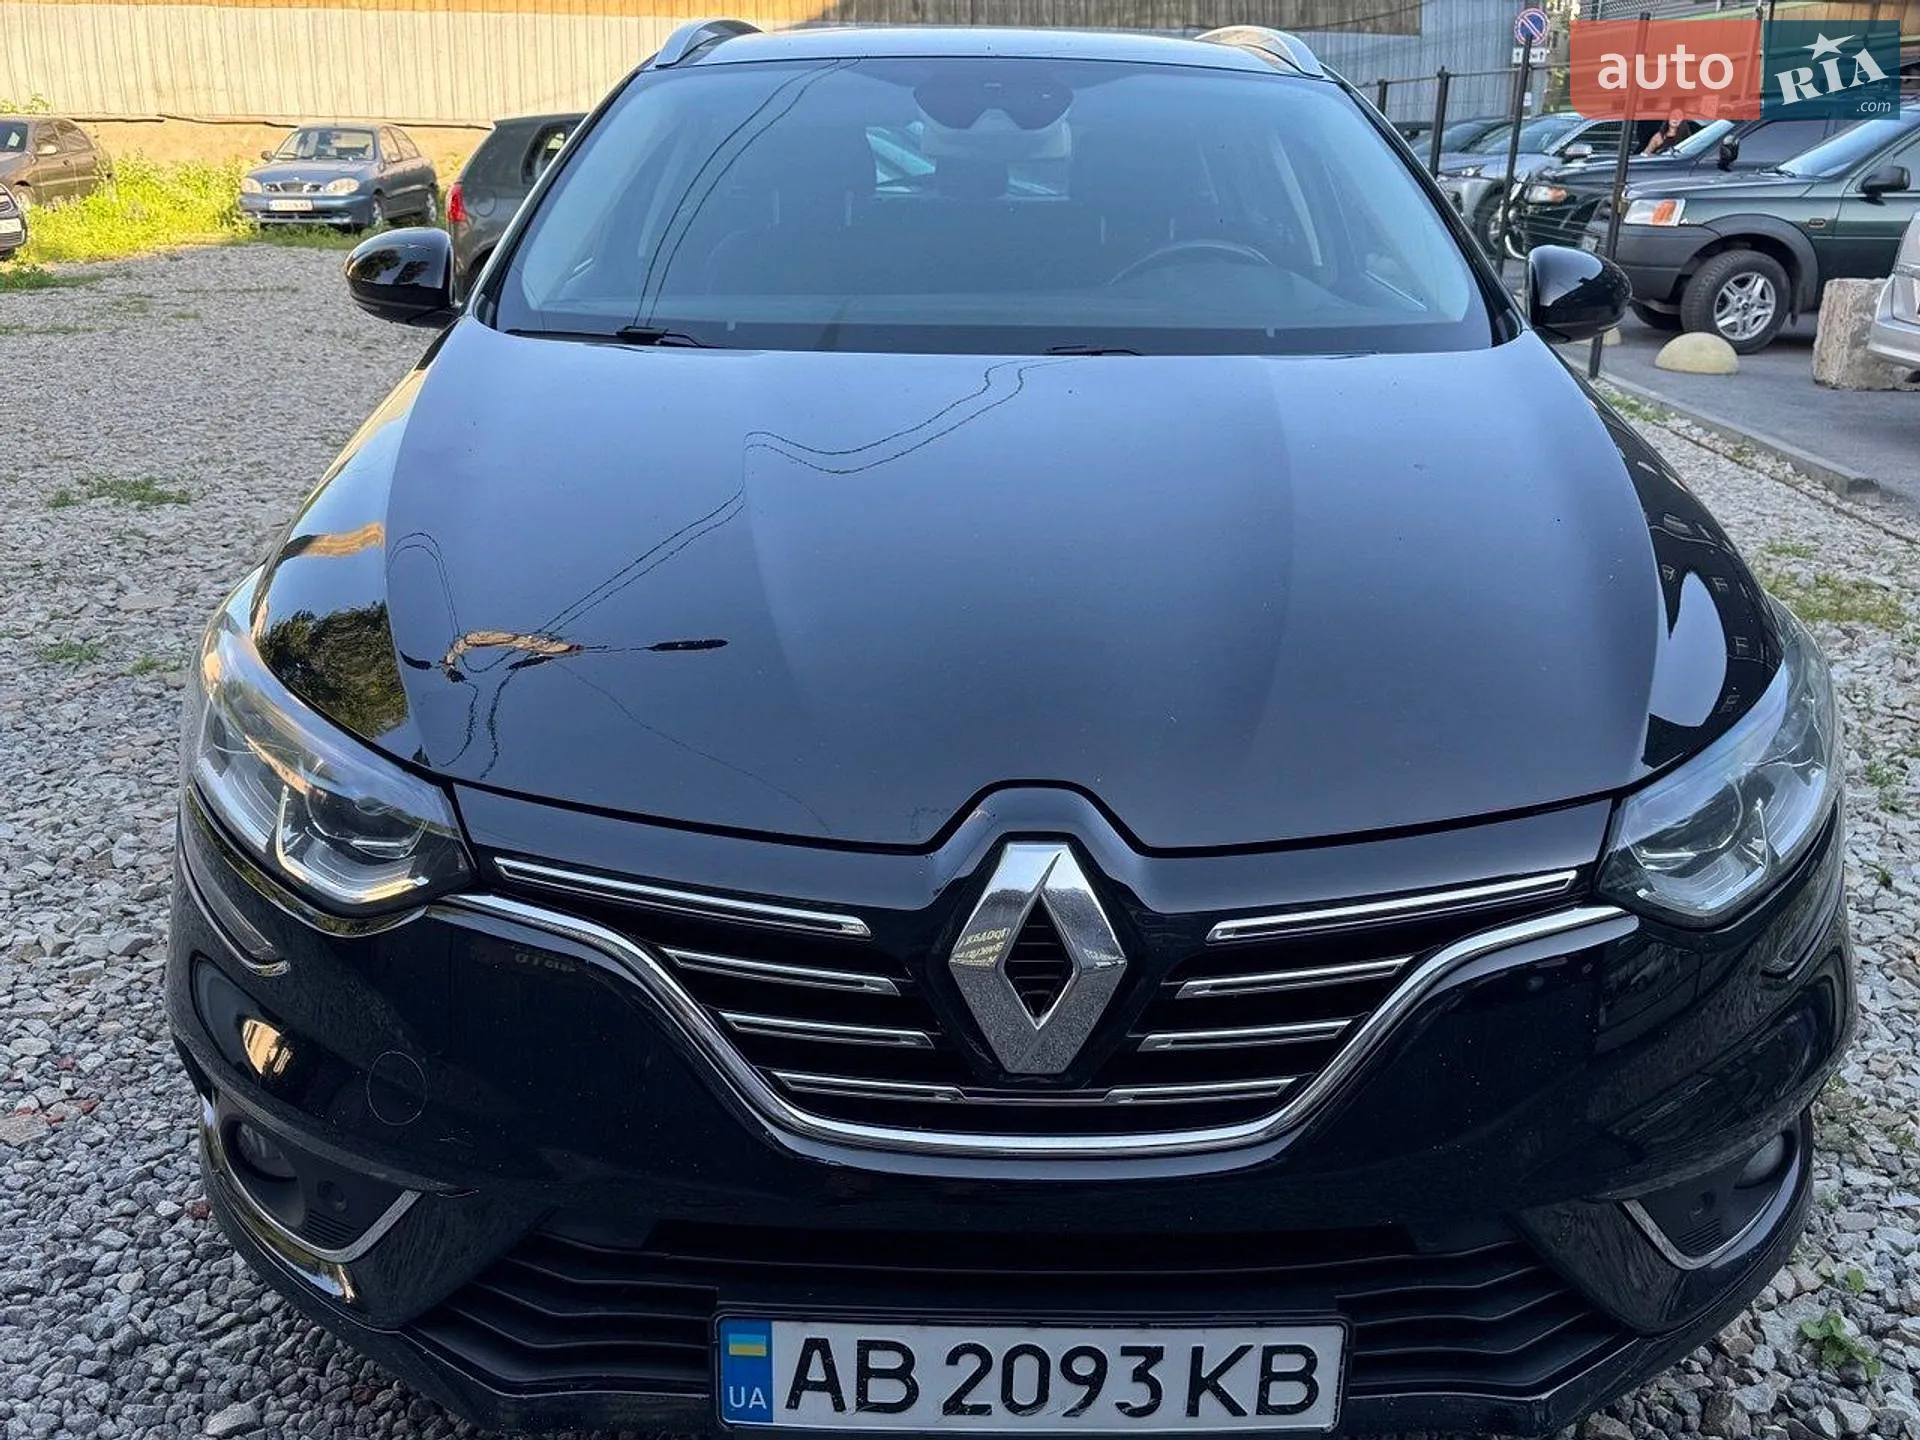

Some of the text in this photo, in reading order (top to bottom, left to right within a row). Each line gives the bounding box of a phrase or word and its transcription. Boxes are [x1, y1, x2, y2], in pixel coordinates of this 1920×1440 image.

[728, 1386, 768, 1410] UA
[785, 1337, 1320, 1419] AB 2093 KB
